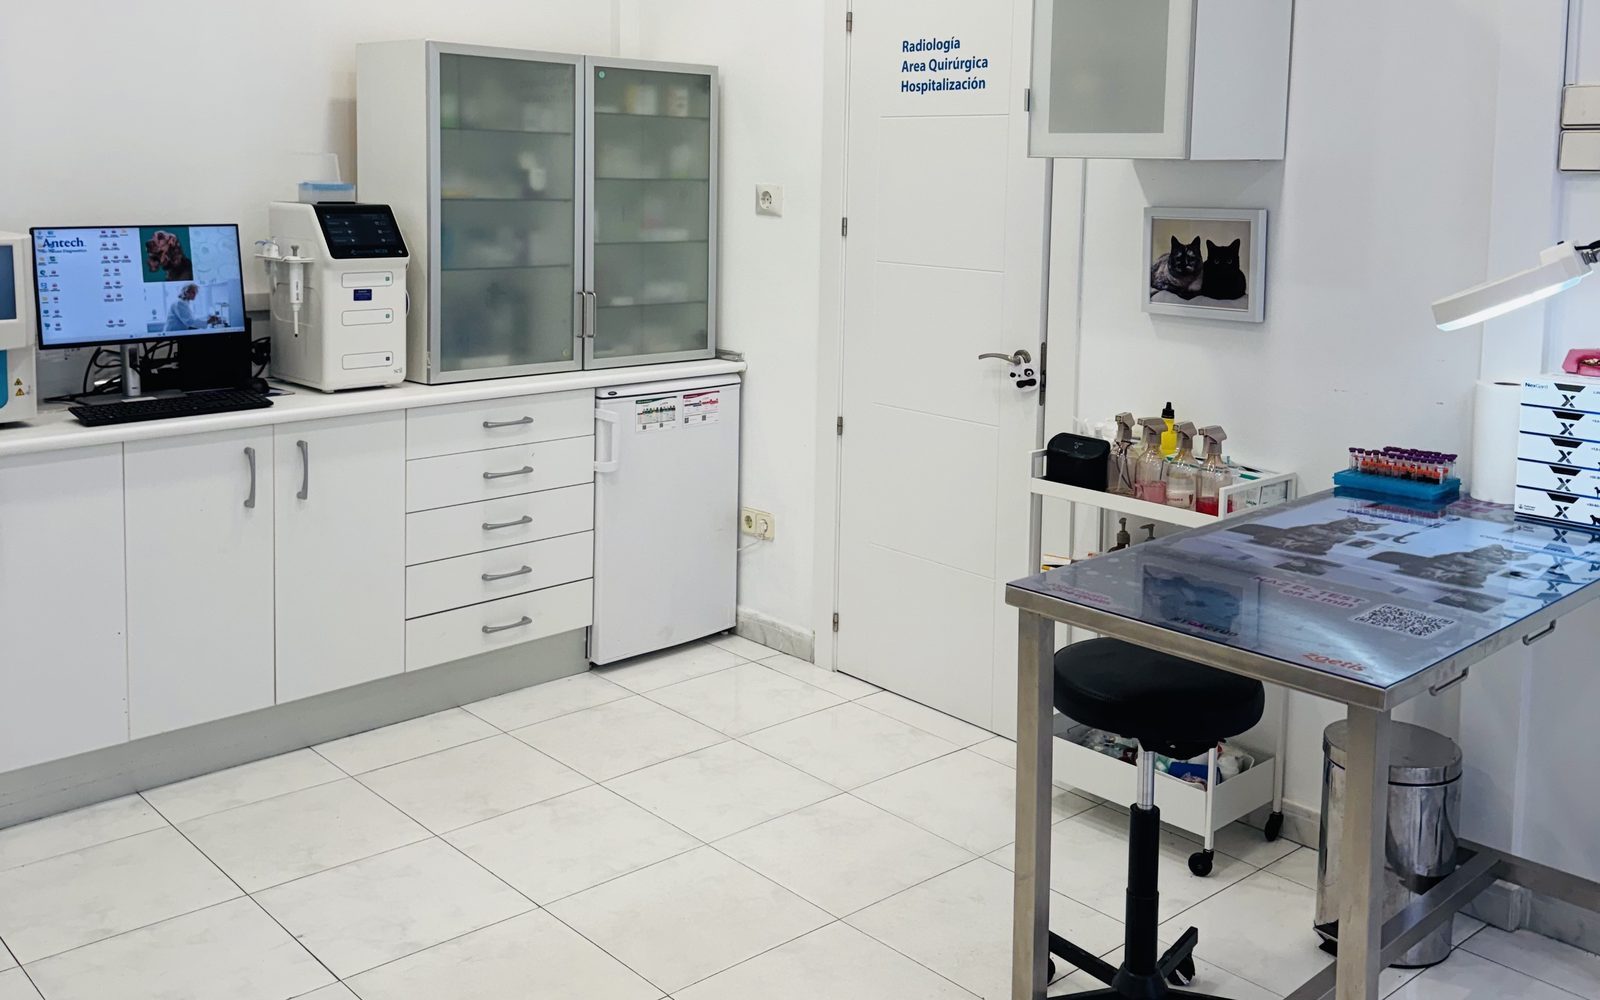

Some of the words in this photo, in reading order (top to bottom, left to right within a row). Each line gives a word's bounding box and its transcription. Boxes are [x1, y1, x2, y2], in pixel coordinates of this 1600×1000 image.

[902, 36, 961, 53] Radiología
[901, 60, 926, 73] Area
[928, 56, 988, 73] Quirúrgica
[901, 76, 986, 95] Hospitalización
[43, 237, 84, 247] Antech
